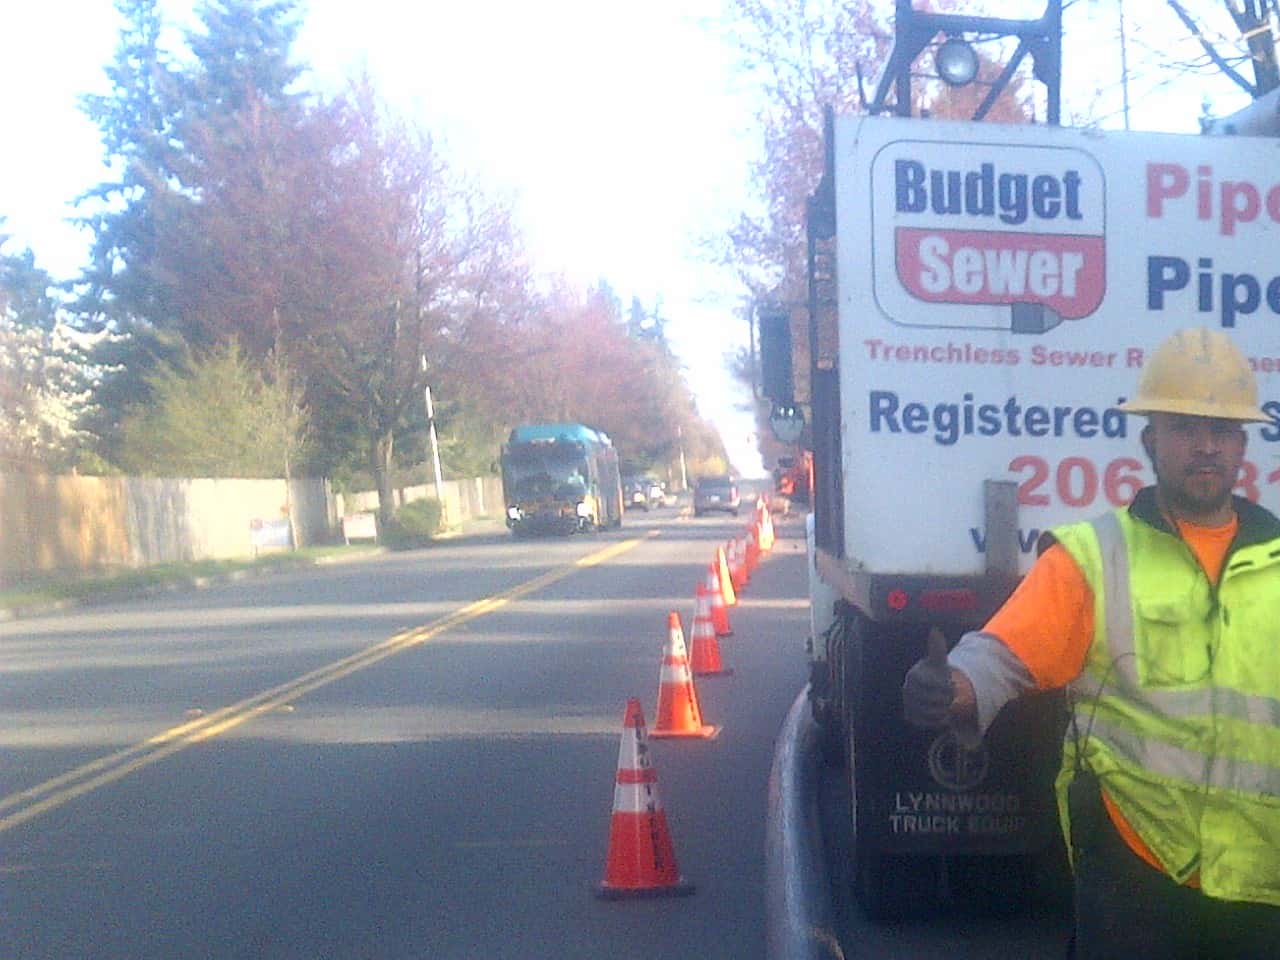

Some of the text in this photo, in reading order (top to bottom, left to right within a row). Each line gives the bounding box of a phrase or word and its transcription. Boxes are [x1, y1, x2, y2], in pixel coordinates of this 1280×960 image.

[895, 160, 1083, 225] Budget
[918, 236, 1084, 299] Sewer
[864, 339, 1020, 366] Trenchless
[1031, 344, 1117, 368] Sewer
[868, 389, 1129, 447] Registered
